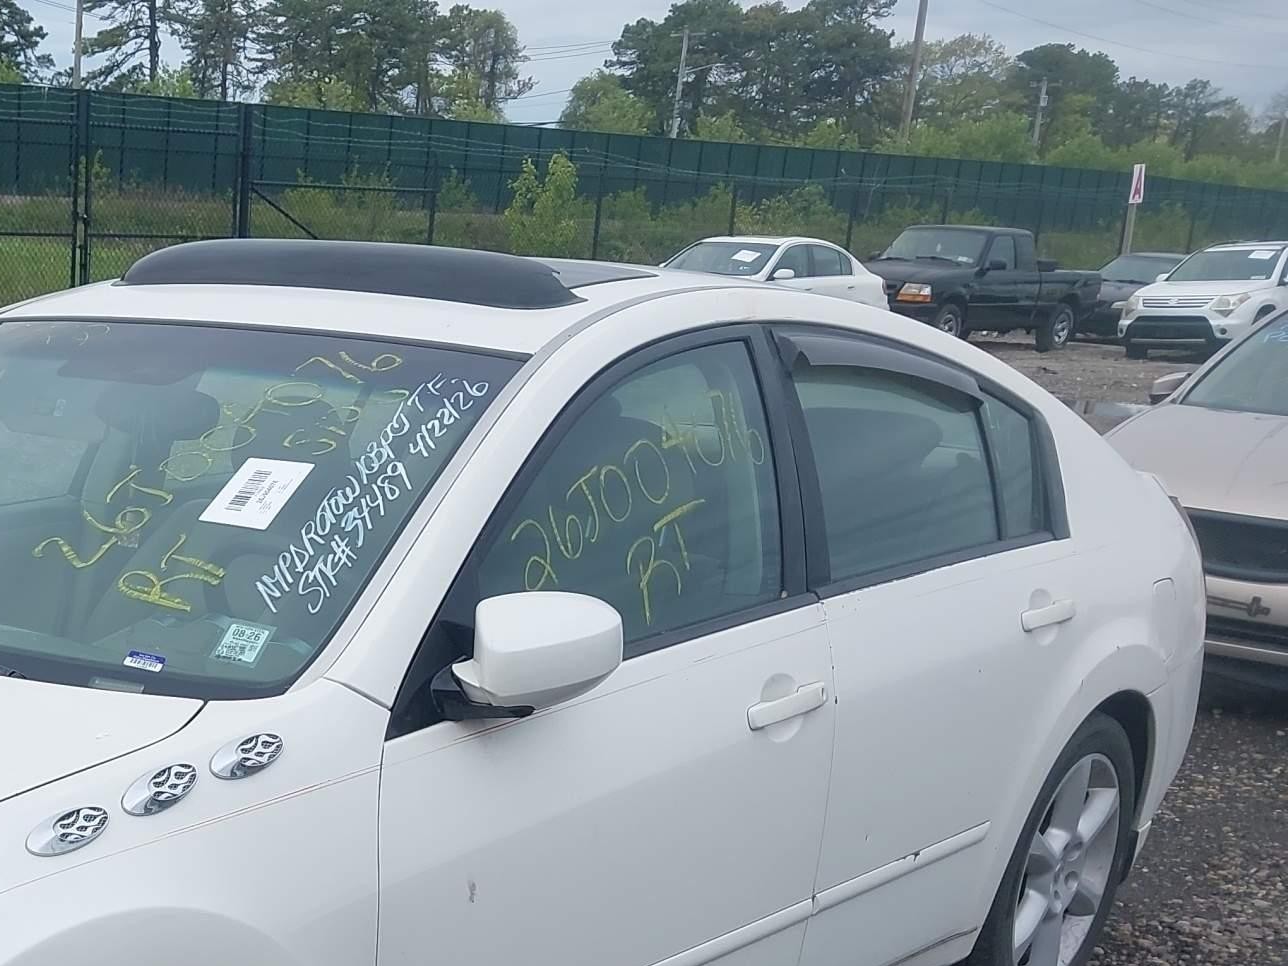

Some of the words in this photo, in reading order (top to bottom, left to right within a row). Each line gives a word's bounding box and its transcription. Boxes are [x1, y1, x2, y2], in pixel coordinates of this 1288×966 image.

[410, 380, 489, 457] 4/22/26
[117, 534, 225, 612] RT
[626, 498, 705, 625] RT
